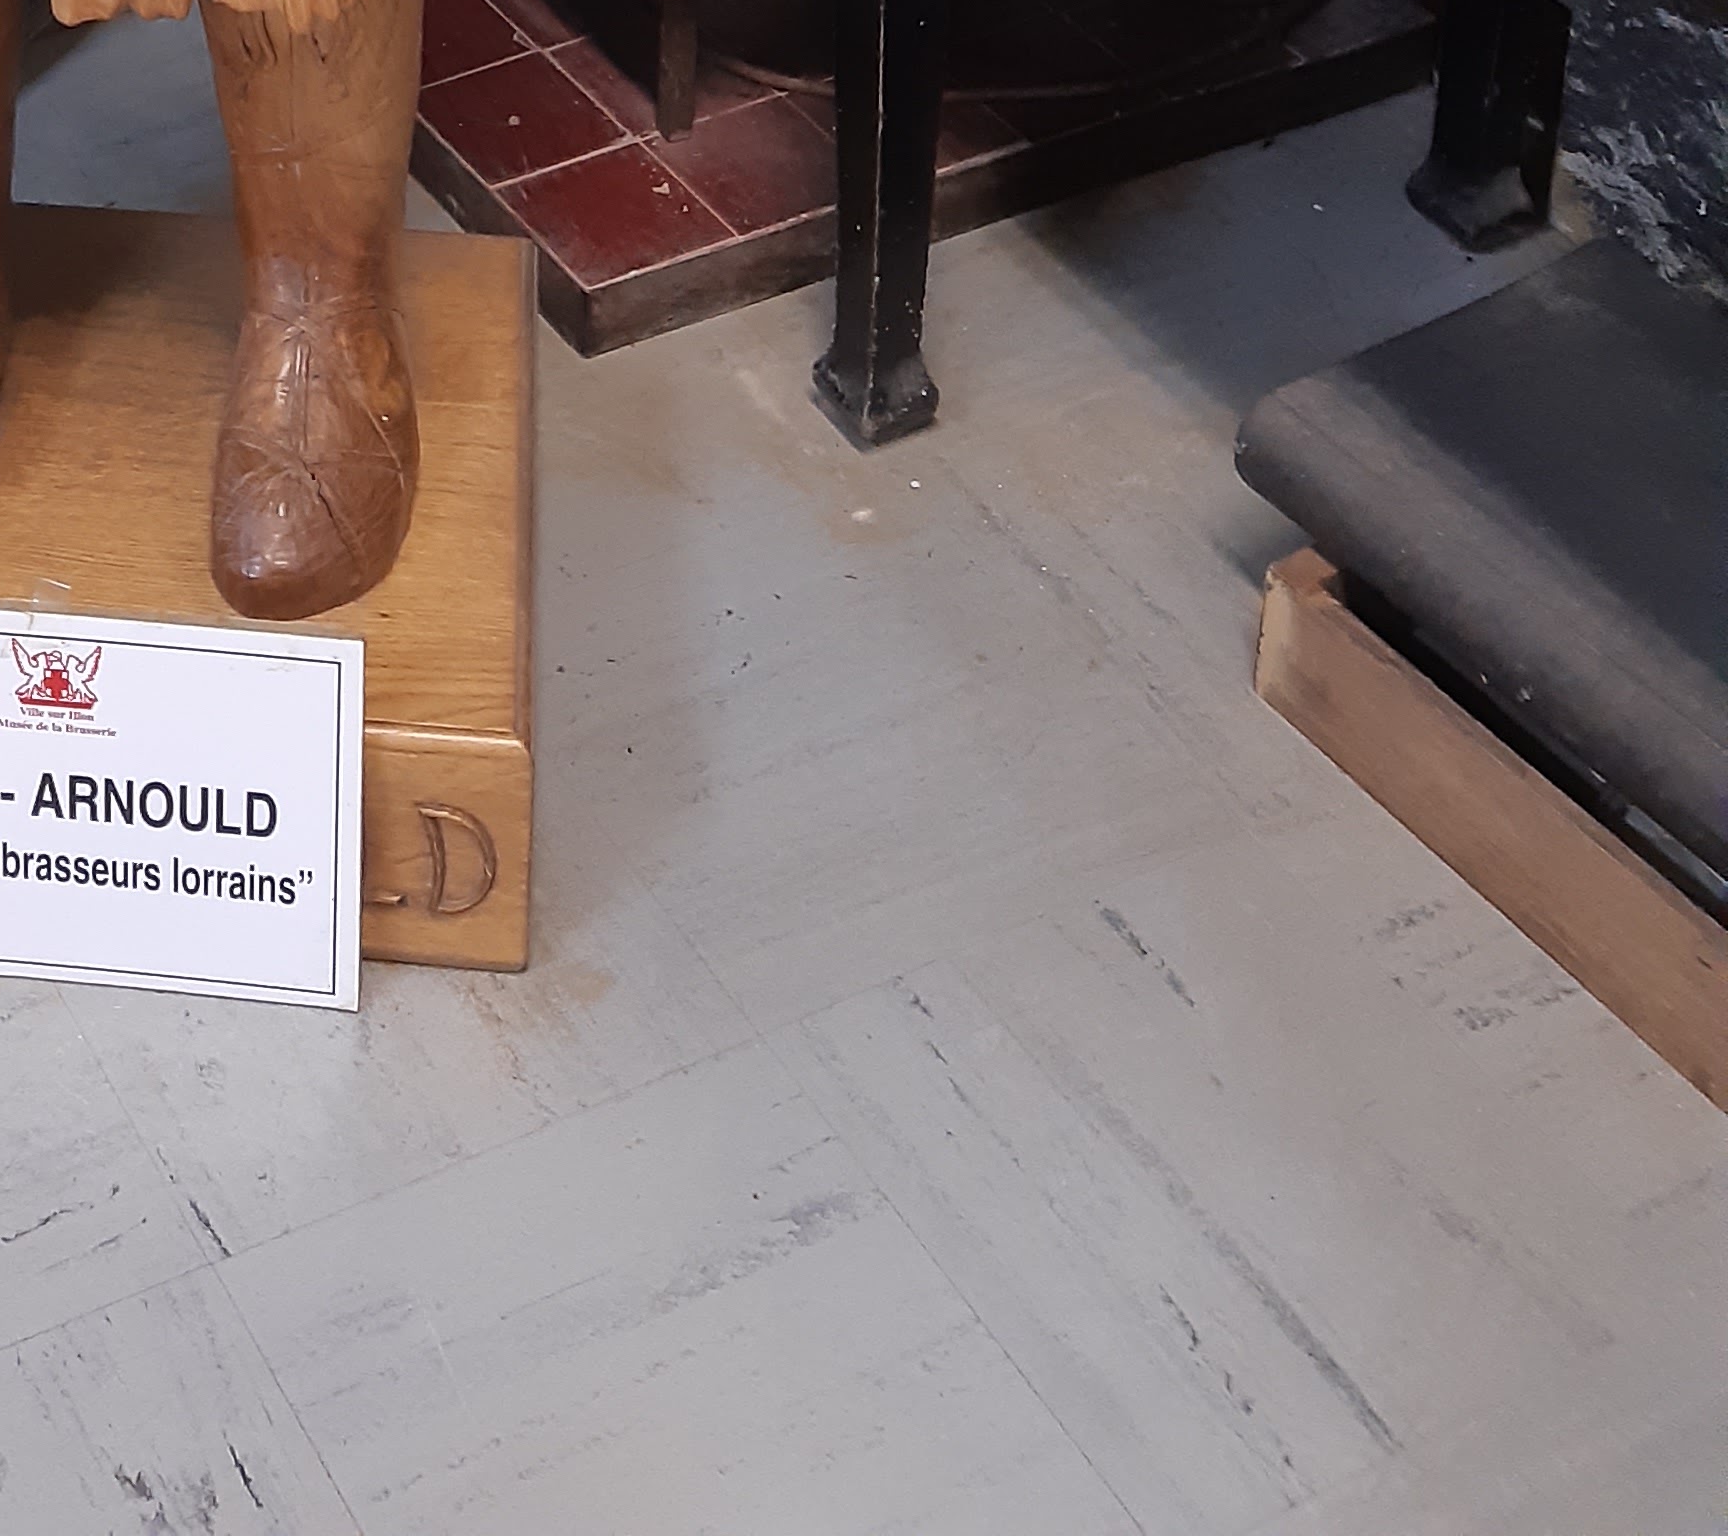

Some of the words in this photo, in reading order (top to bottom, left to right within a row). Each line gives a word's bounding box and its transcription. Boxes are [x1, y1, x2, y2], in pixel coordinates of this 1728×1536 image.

[20, 706, 44, 718] Ville
[47, 710, 66, 719] sur
[36, 721, 49, 732] de
[51, 722, 63, 733] la
[65, 723, 117, 737] Brasserie
[0, 790, 18, 801] -
[30, 770, 280, 840] ARNOULD
[0, 840, 163, 894] brasseurs
[170, 858, 314, 910] lorrains”
